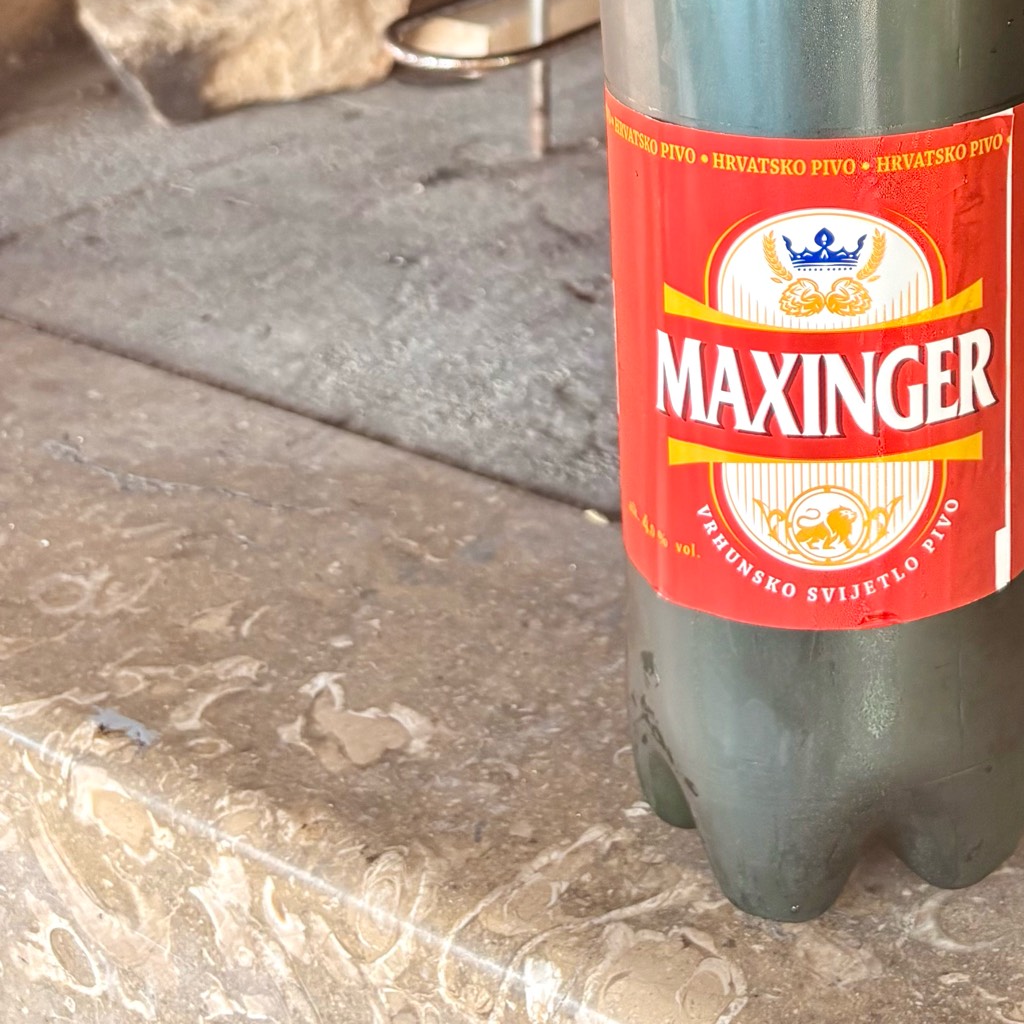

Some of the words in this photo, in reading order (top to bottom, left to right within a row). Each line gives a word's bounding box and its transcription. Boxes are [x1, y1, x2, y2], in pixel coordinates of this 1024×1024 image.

[613, 116, 658, 156] HRVATSKO
[660, 141, 697, 164] PIVO
[712, 152, 807, 176] HRVATSKO
[811, 158, 856, 176] PIVO
[877, 143, 967, 173] HRVATSKO
[970, 133, 1003, 158] PIVO
[655, 328, 999, 438] MAXINGER
[675, 542, 701, 559] vol.
[696, 504, 797, 598] VRHUNSKO
[806, 556, 919, 603] SVIJETLO
[921, 498, 960, 554] PIVO
